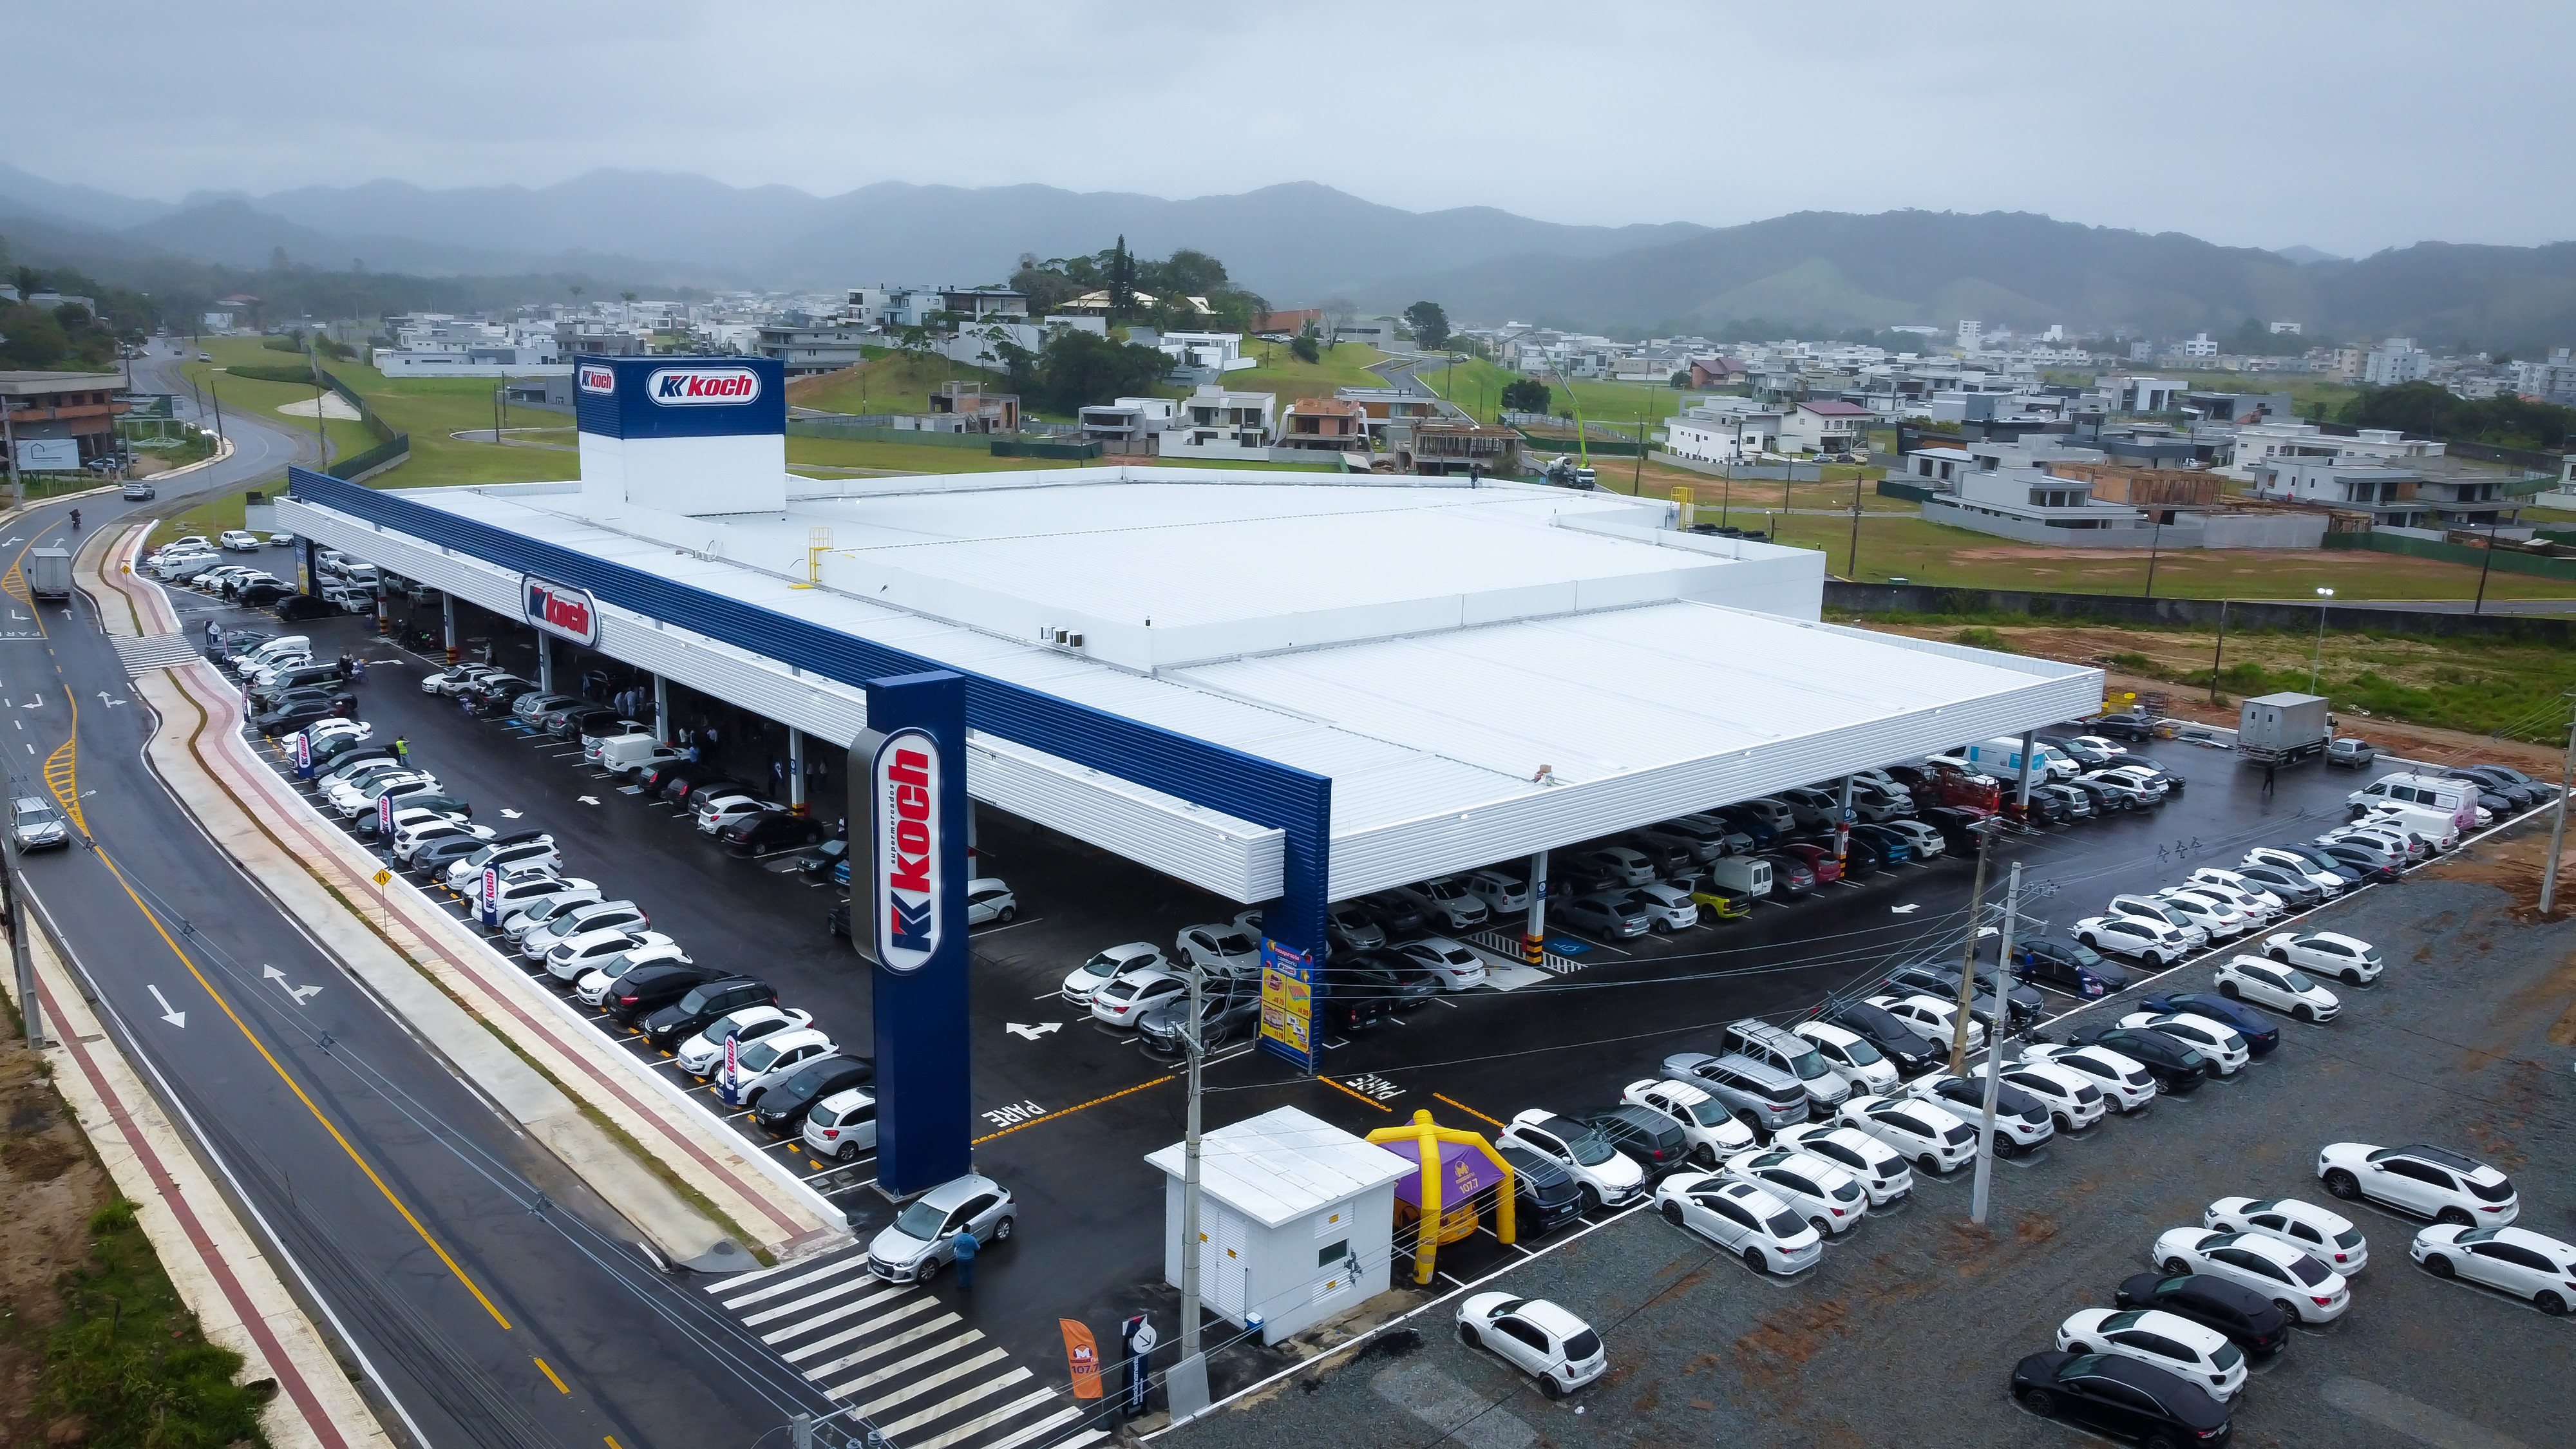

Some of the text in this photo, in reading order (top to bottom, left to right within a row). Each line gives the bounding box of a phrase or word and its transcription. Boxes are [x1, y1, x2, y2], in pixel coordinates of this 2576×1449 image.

[687, 375, 752, 397] koch
[545, 591, 589, 636] koch
[888, 748, 930, 893] koch
[1346, 1074, 1406, 1100] PARE
[981, 1099, 1048, 1128] PARE
